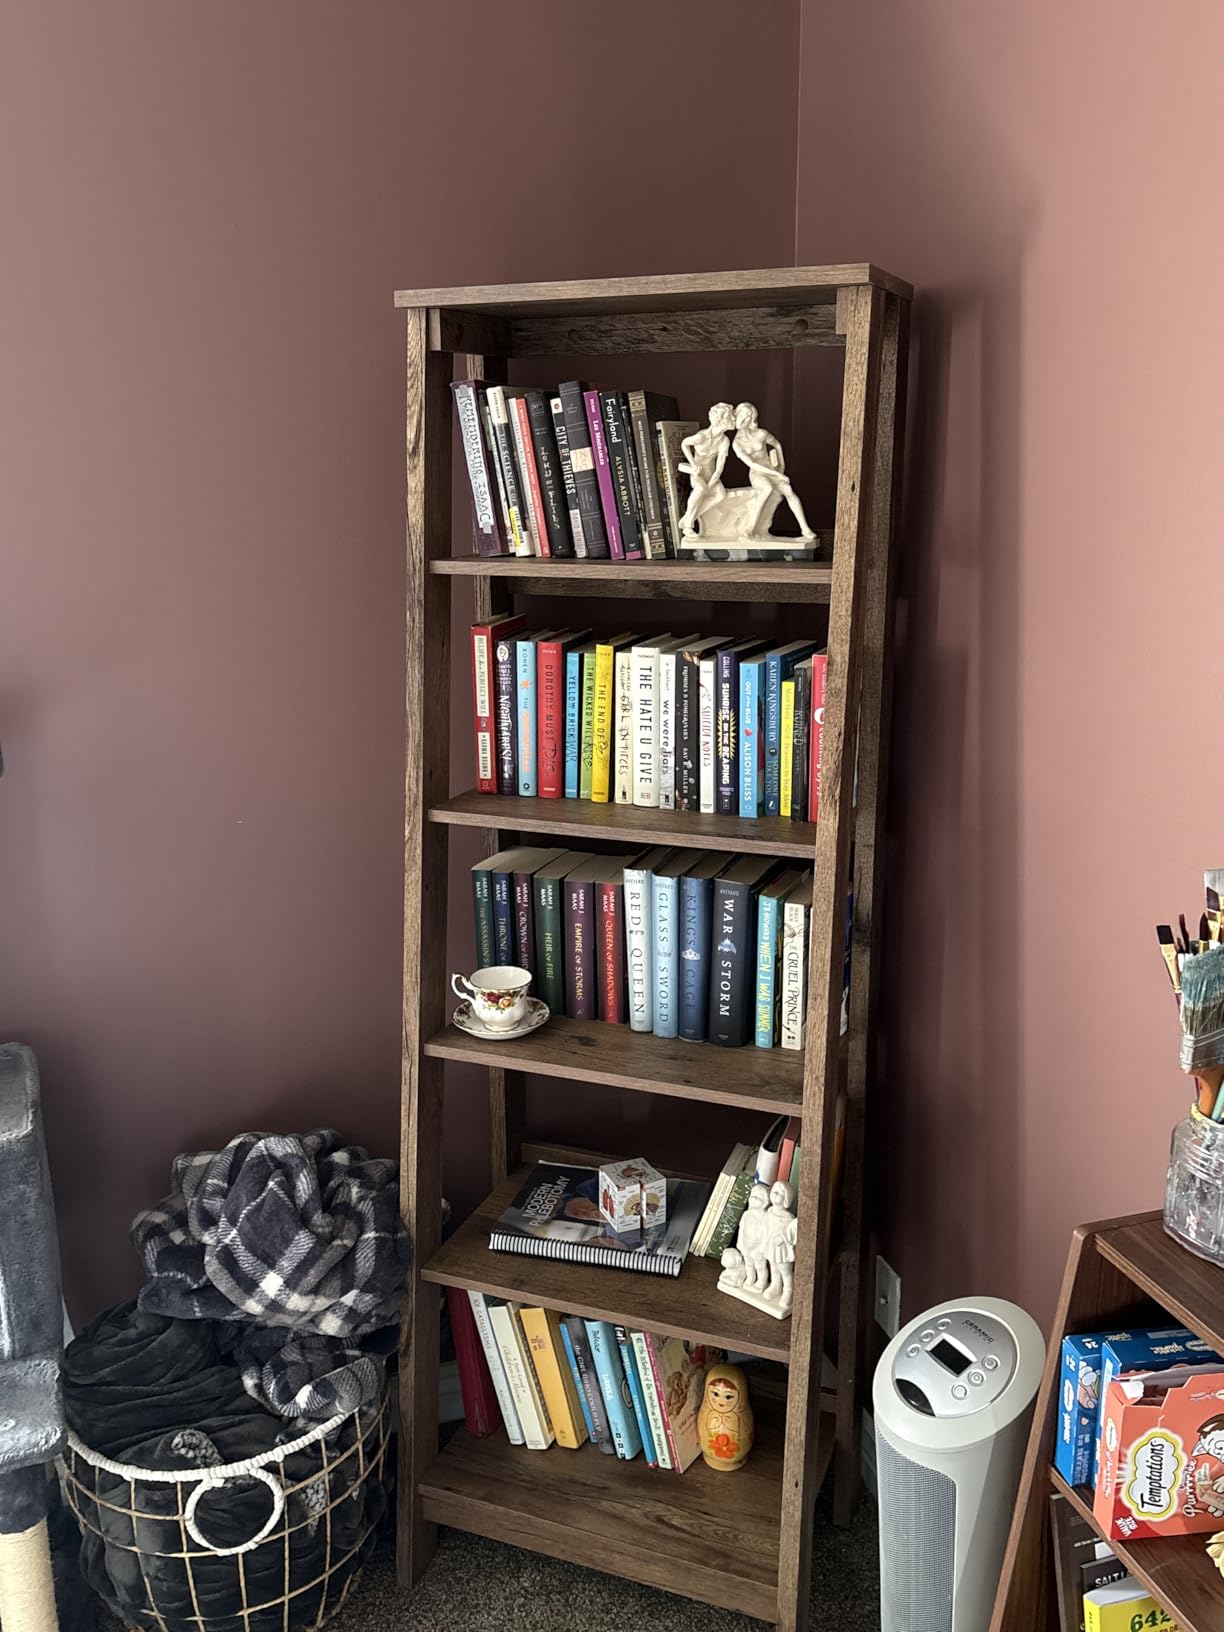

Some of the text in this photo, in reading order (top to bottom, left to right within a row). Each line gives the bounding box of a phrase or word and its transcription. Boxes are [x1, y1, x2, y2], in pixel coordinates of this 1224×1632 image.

[501, 450, 514, 491] SCIENCE
[556, 426, 576, 495] CITY OF THIEVES
[605, 398, 631, 516] Fairyland ALYSIA ABBOTT
[479, 482, 491, 524] ISAAC
[545, 664, 554, 710] DOROTHY
[722, 656, 731, 678] COLLINS
[568, 675, 577, 709] YELLOW
[586, 685, 594, 717] WICKED
[596, 684, 607, 739] THE END OF
[721, 682, 730, 721] SUNRISE
[744, 681, 752, 724] OUT BLUE
[767, 661, 777, 743] KAREN KINGSBURY
[545, 714, 554, 741] MUST
[567, 712, 576, 738] BRICK
[618, 693, 632, 776] GIRL IN PIECES
[639, 666, 653, 784] THE HATE U GIVE
[662, 699, 673, 775] we were liars
[702, 705, 712, 767] SUICIDE NOTES
[682, 769, 690, 794] MILLER
[721, 746, 730, 785] REAPING
[743, 741, 752, 802] ALISON BLISS
[498, 917, 507, 950] THRONE
[519, 911, 528, 944] CROWN
[544, 932, 554, 979] HEIR OF FIRE
[574, 922, 584, 1001] EMPIRE OF STORMS
[605, 920, 615, 1006] QUEEN OF SHADOWS
[630, 891, 645, 1014] RED QUEEN
[658, 892, 669, 1023] GLASS SWORD
[686, 895, 696, 1009] KING'S CAGE
[719, 899, 735, 1017] WAR STORM
[759, 941, 772, 972] WHEN
[759, 982, 771, 1002] WAS
[784, 951, 800, 1028] CRUEL PRINCE
[522, 1183, 553, 1218] MODERN
[530, 1176, 570, 1226] PHLEBOTOMY
[574, 1344, 583, 1355] the
[964, 1319, 994, 1343] CERAMIC
[577, 1356, 587, 1372] GIRL
[581, 1373, 591, 1391] WHO
[585, 1391, 599, 1417] COULD
[1140, 1441, 1167, 1508] Temptations
[1115, 1517, 1133, 1537] VALUE
[1126, 1516, 1138, 1530] SIZE
